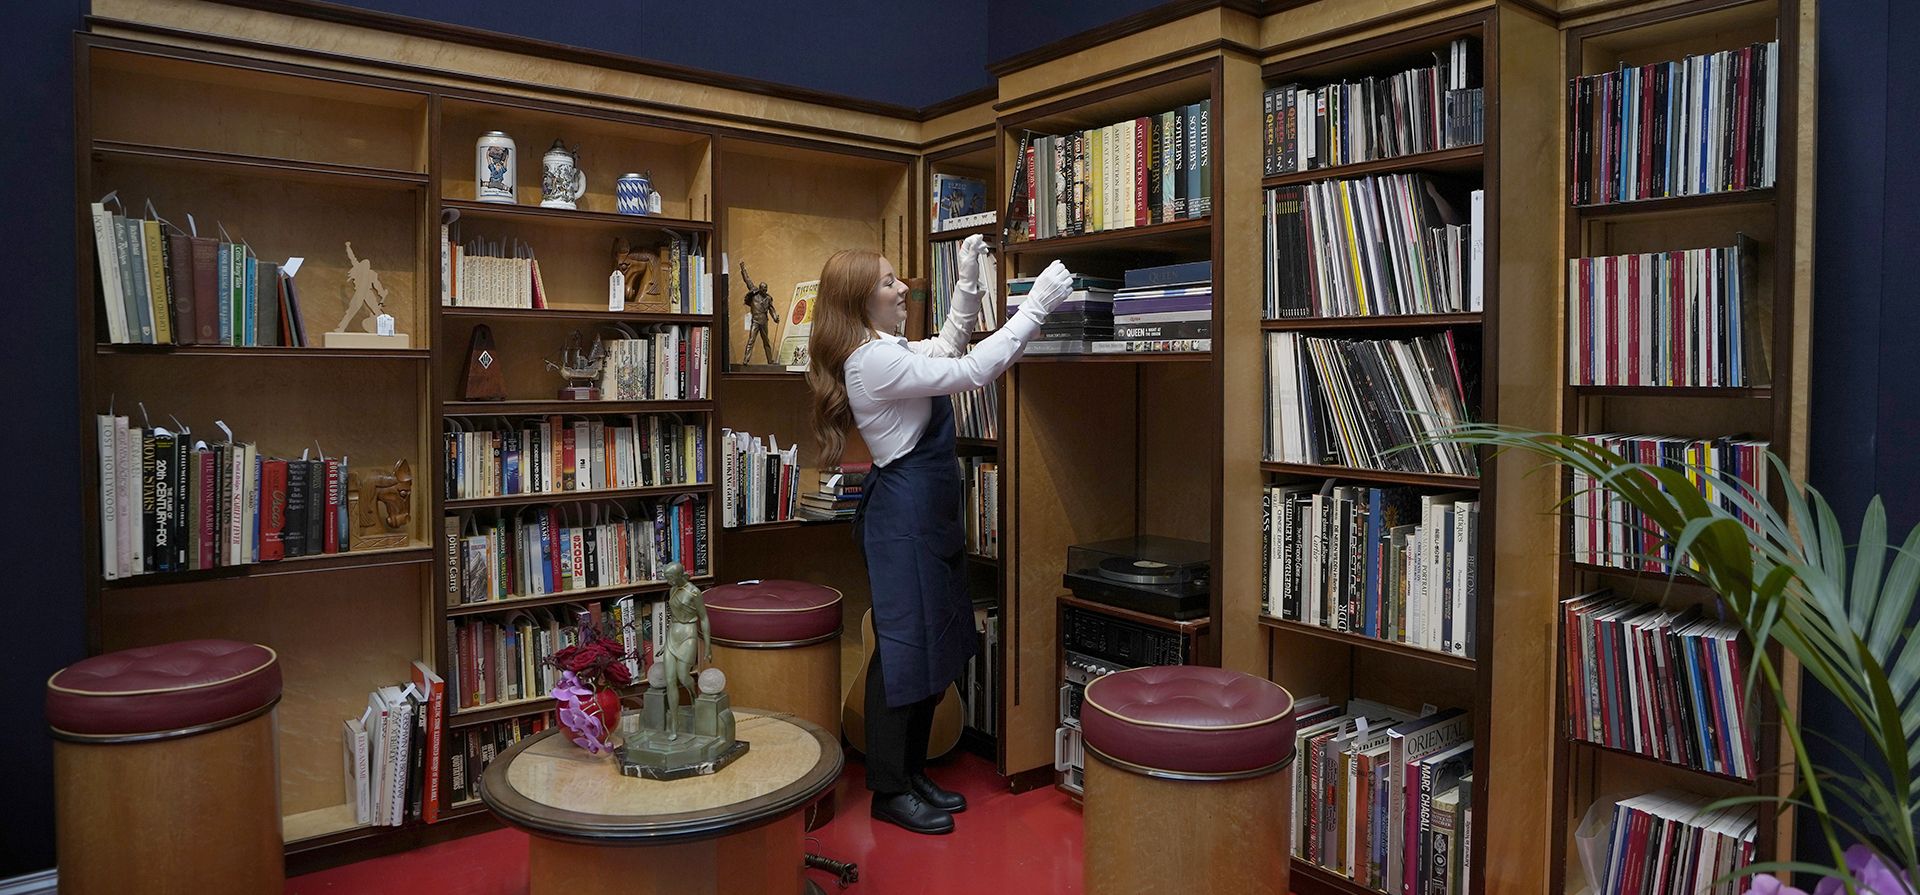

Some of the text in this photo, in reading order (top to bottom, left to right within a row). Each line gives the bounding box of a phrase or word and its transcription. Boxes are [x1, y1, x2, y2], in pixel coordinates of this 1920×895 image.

[1175, 115, 1183, 171] SOTHEBY'S
[1189, 115, 1197, 171] SOTHEBY'S
[1201, 110, 1209, 167] SOTHEBY'S
[1126, 327, 1145, 338] QUEEN
[104, 424, 115, 522] LOST HOLLYWOOD
[144, 437, 155, 511] MOVIE STARS
[206, 458, 215, 472] THE
[206, 474, 214, 502] DIVINE
[156, 459, 167, 547] 20th CENTURY-FOX
[1455, 506, 1466, 543] Antiques
[447, 534, 459, 592] John le Carré
[1313, 535, 1321, 562] Cartier
[1466, 555, 1475, 596] BEATON
[1338, 604, 1347, 631] DDR
[1408, 721, 1465, 755] ORIENTAL
[1420, 764, 1431, 832] MARC CHAGALL
